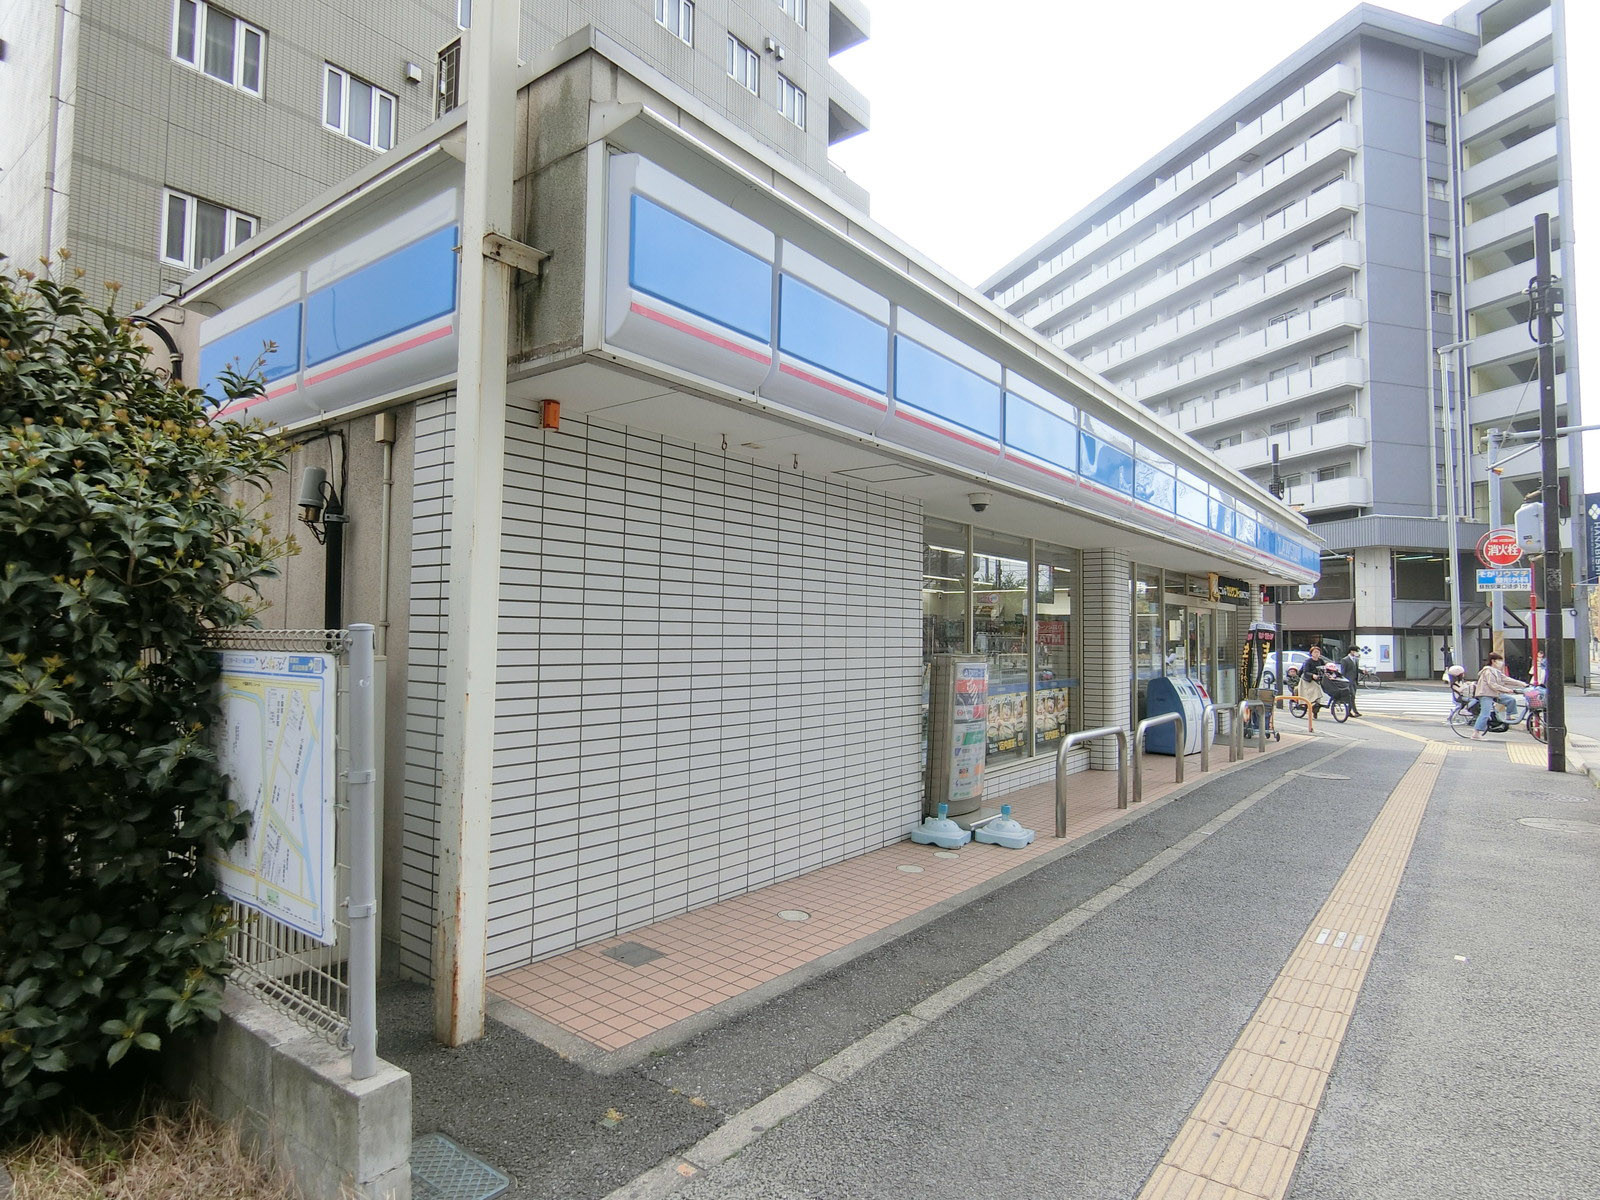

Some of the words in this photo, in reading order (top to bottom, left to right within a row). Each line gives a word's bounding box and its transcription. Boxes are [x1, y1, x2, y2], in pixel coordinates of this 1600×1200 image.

[1487, 544, 1519, 556] 消火栓
[1039, 634, 1061, 643] ATM
